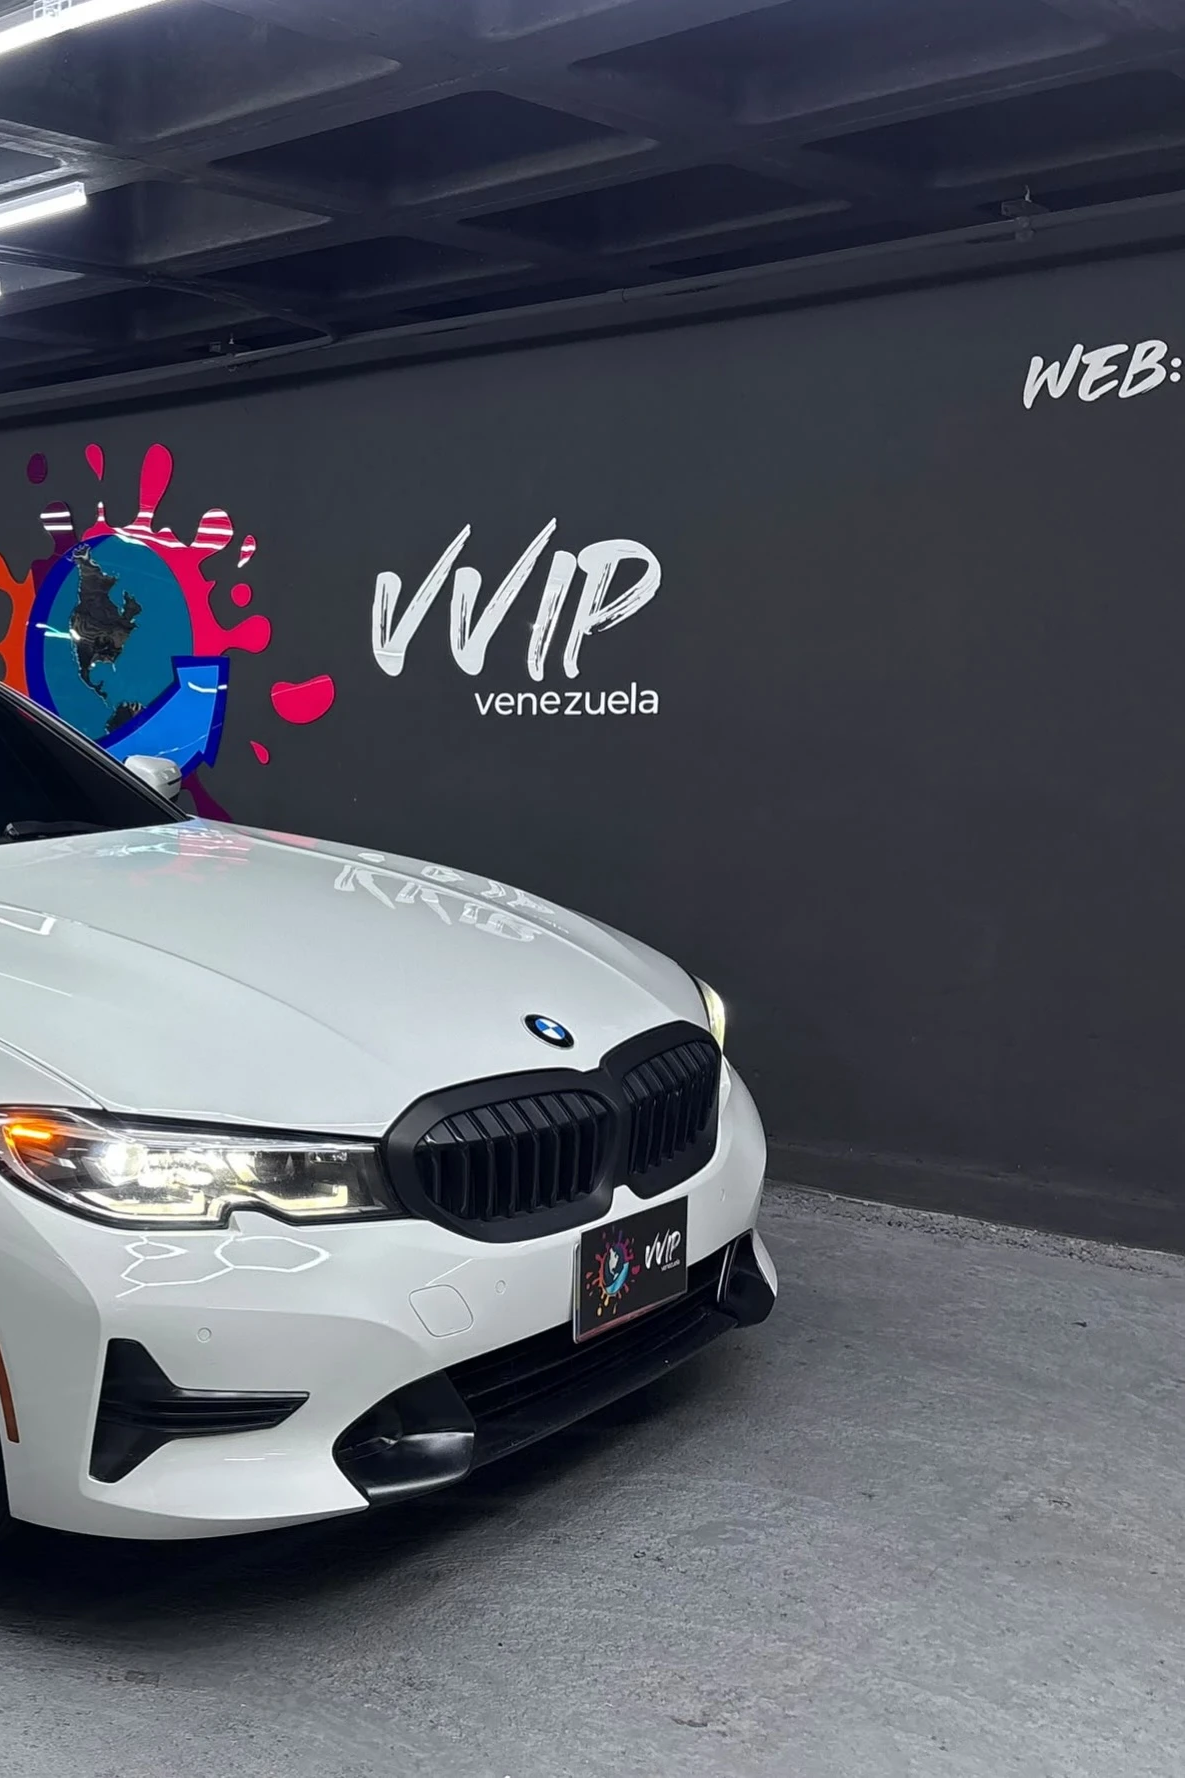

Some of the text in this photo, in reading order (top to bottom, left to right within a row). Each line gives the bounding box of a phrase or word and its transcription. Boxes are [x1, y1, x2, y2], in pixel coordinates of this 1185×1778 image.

[1022, 339, 1182, 409] WEB:
[371, 517, 662, 682] VVIP
[474, 682, 660, 716] venezuela
[645, 1228, 681, 1269] VVIP
